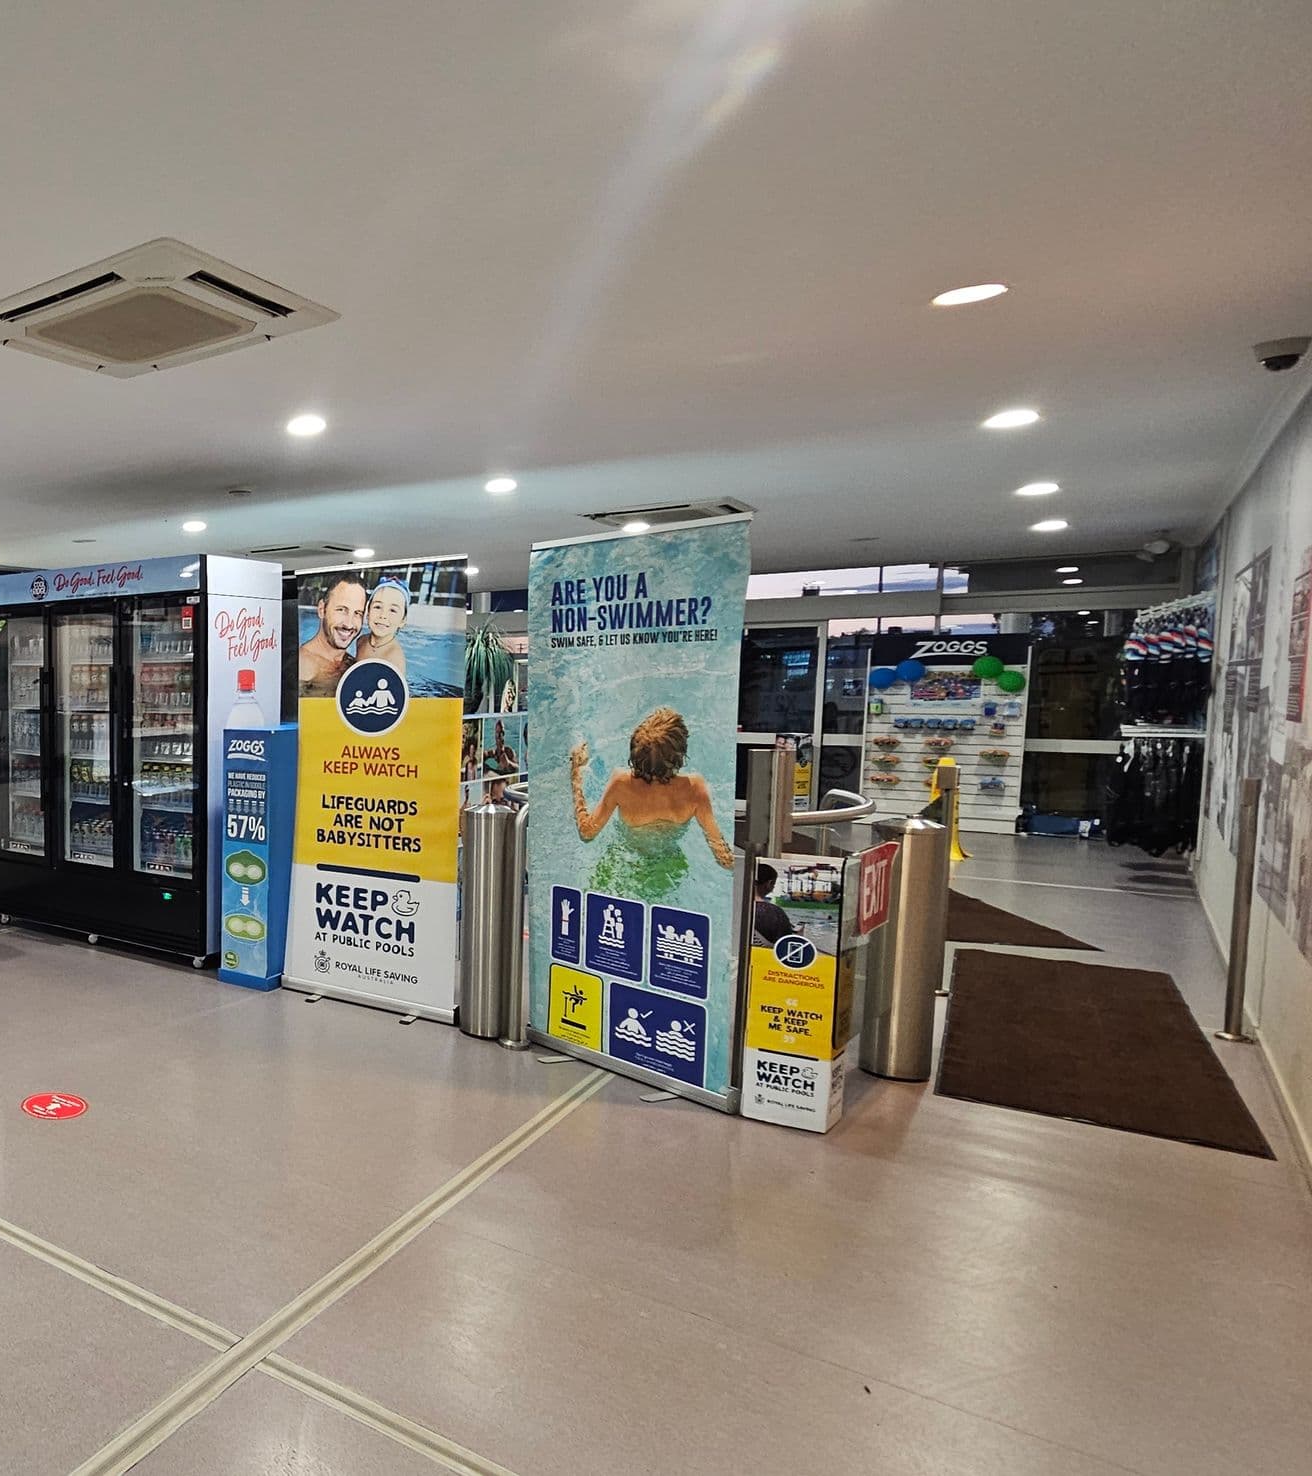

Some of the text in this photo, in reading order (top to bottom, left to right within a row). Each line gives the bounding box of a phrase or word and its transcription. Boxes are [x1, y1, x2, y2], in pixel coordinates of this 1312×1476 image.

[53, 573, 68, 591] Do
[97, 568, 115, 587] Feel
[551, 572, 648, 606] ARE YOU A
[214, 606, 264, 640] Do Good.
[551, 596, 712, 633] NON-SWIMMER?
[228, 635, 248, 661] Feel
[551, 635, 574, 648] SWIM
[576, 635, 597, 648] SAFE,
[605, 634, 618, 646] LET
[620, 633, 631, 645] US
[633, 631, 660, 644] KNOW
[661, 630, 693, 643] YOU'RE
[694, 629, 717, 642] HERE!
[909, 640, 988, 659] ZOGGS
[228, 740, 265, 755] ZOGGS
[341, 745, 401, 761] ALWAYS
[323, 760, 418, 778] KEEP WATCH
[228, 788, 266, 799] PACKAGING BY
[322, 794, 418, 816] LIFEGUARDS
[227, 814, 266, 841] 57%
[333, 813, 405, 833] ARE NOT
[316, 828, 422, 853] BABYSITTERS
[315, 882, 389, 912] KEEP
[863, 859, 888, 921] EXIT
[315, 907, 415, 944] WATCH
[314, 932, 415, 957] AT PUBLIC POOLS
[335, 961, 418, 985] ROYAL LIFE SAVING
[767, 969, 820, 982] DISTRACTIONS
[777, 977, 825, 989] DANGEROUS
[760, 1004, 823, 1021] KEEP WATCH
[773, 1015, 808, 1027] & KEEP
[768, 1023, 812, 1037] ME SAFE.
[756, 1060, 800, 1076] KEEP
[756, 1070, 815, 1091] WATCH
[766, 1084, 790, 1093] PUBLIC
[791, 1088, 815, 1097] POOLS
